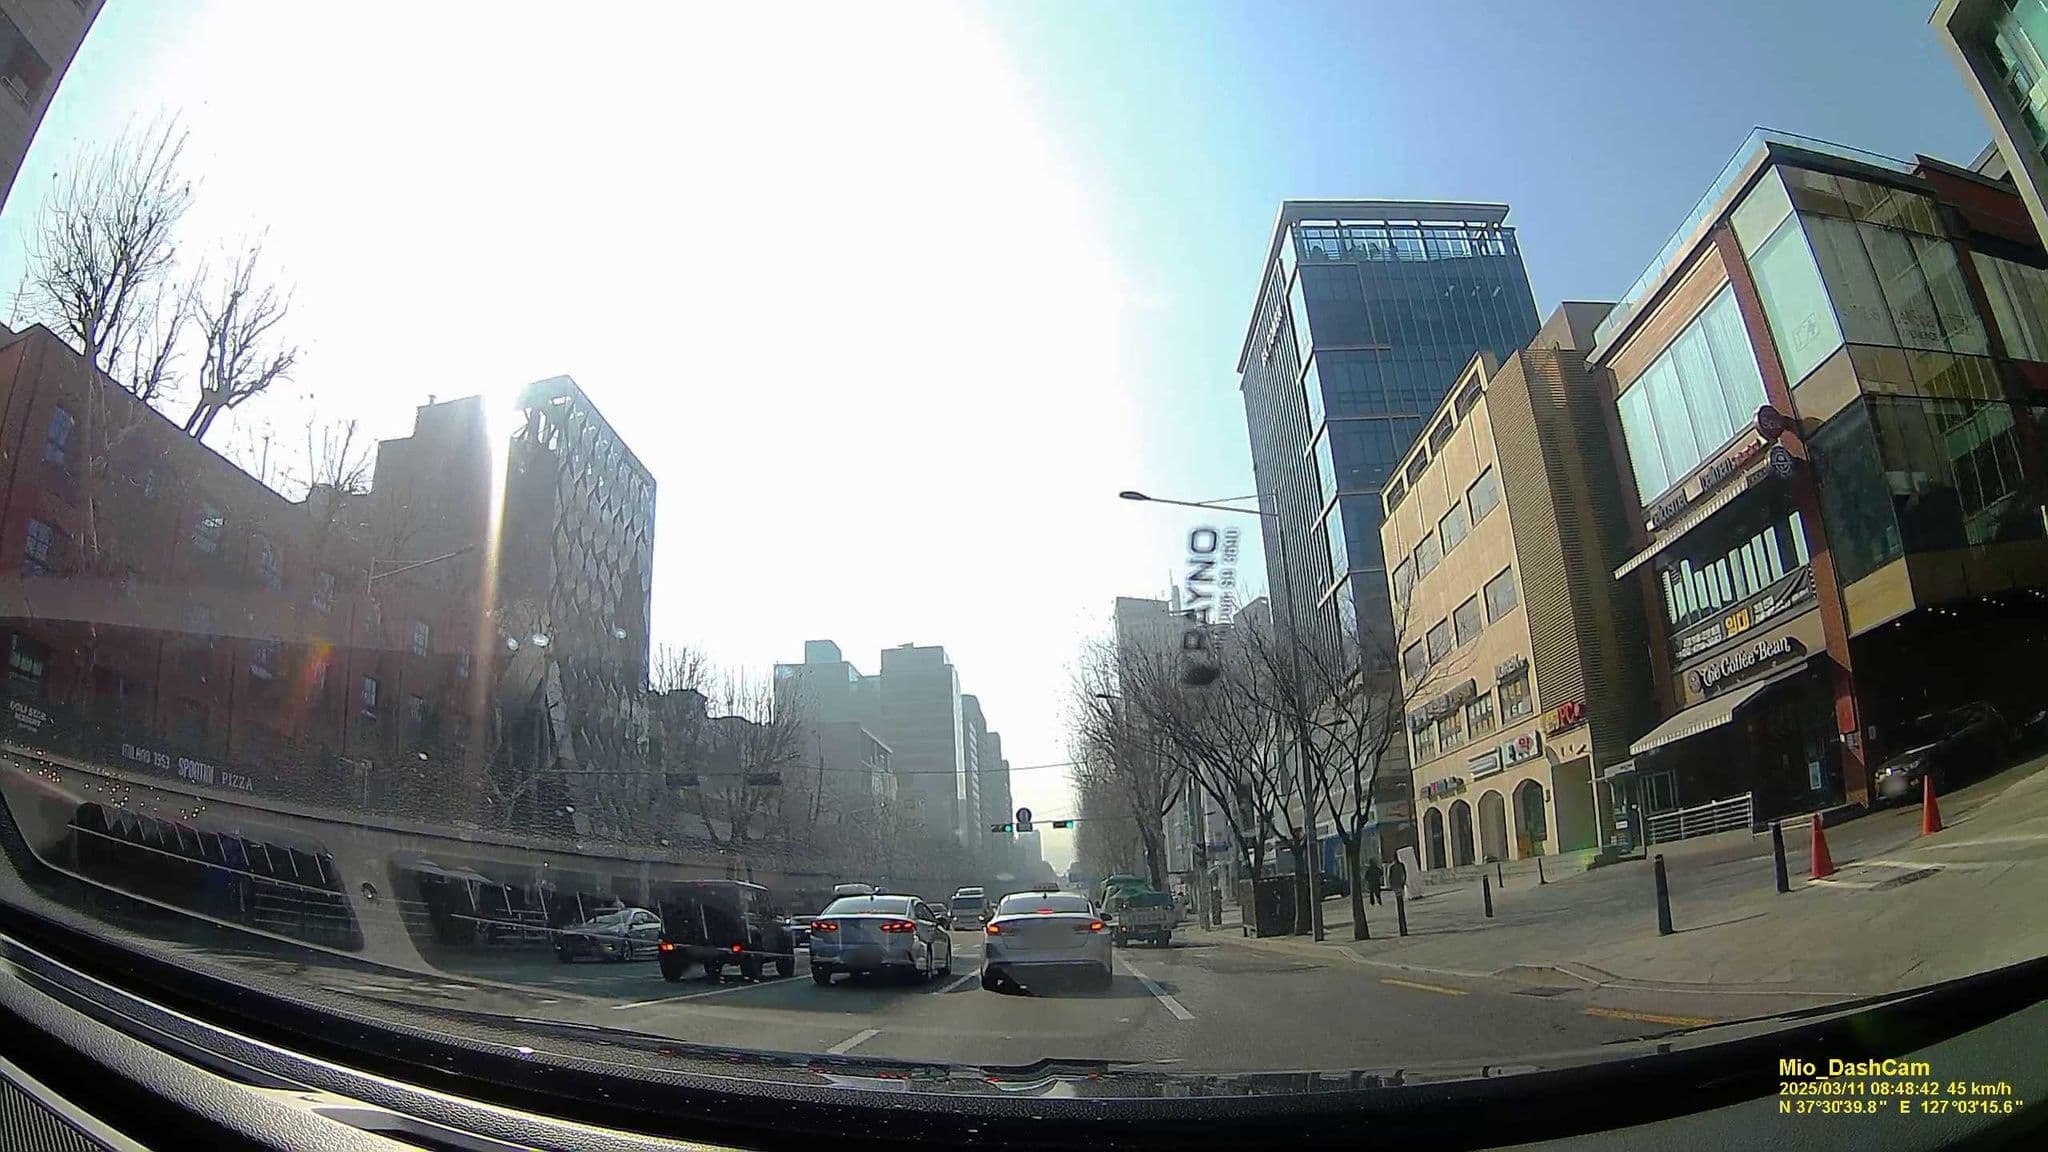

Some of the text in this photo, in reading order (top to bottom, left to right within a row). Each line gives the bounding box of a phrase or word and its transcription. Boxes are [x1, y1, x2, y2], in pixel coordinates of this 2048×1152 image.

[1724, 608, 1751, 638] 임대
[1700, 636, 1791, 687] The Coffee Bean
[222, 771, 254, 792] PIZZA
